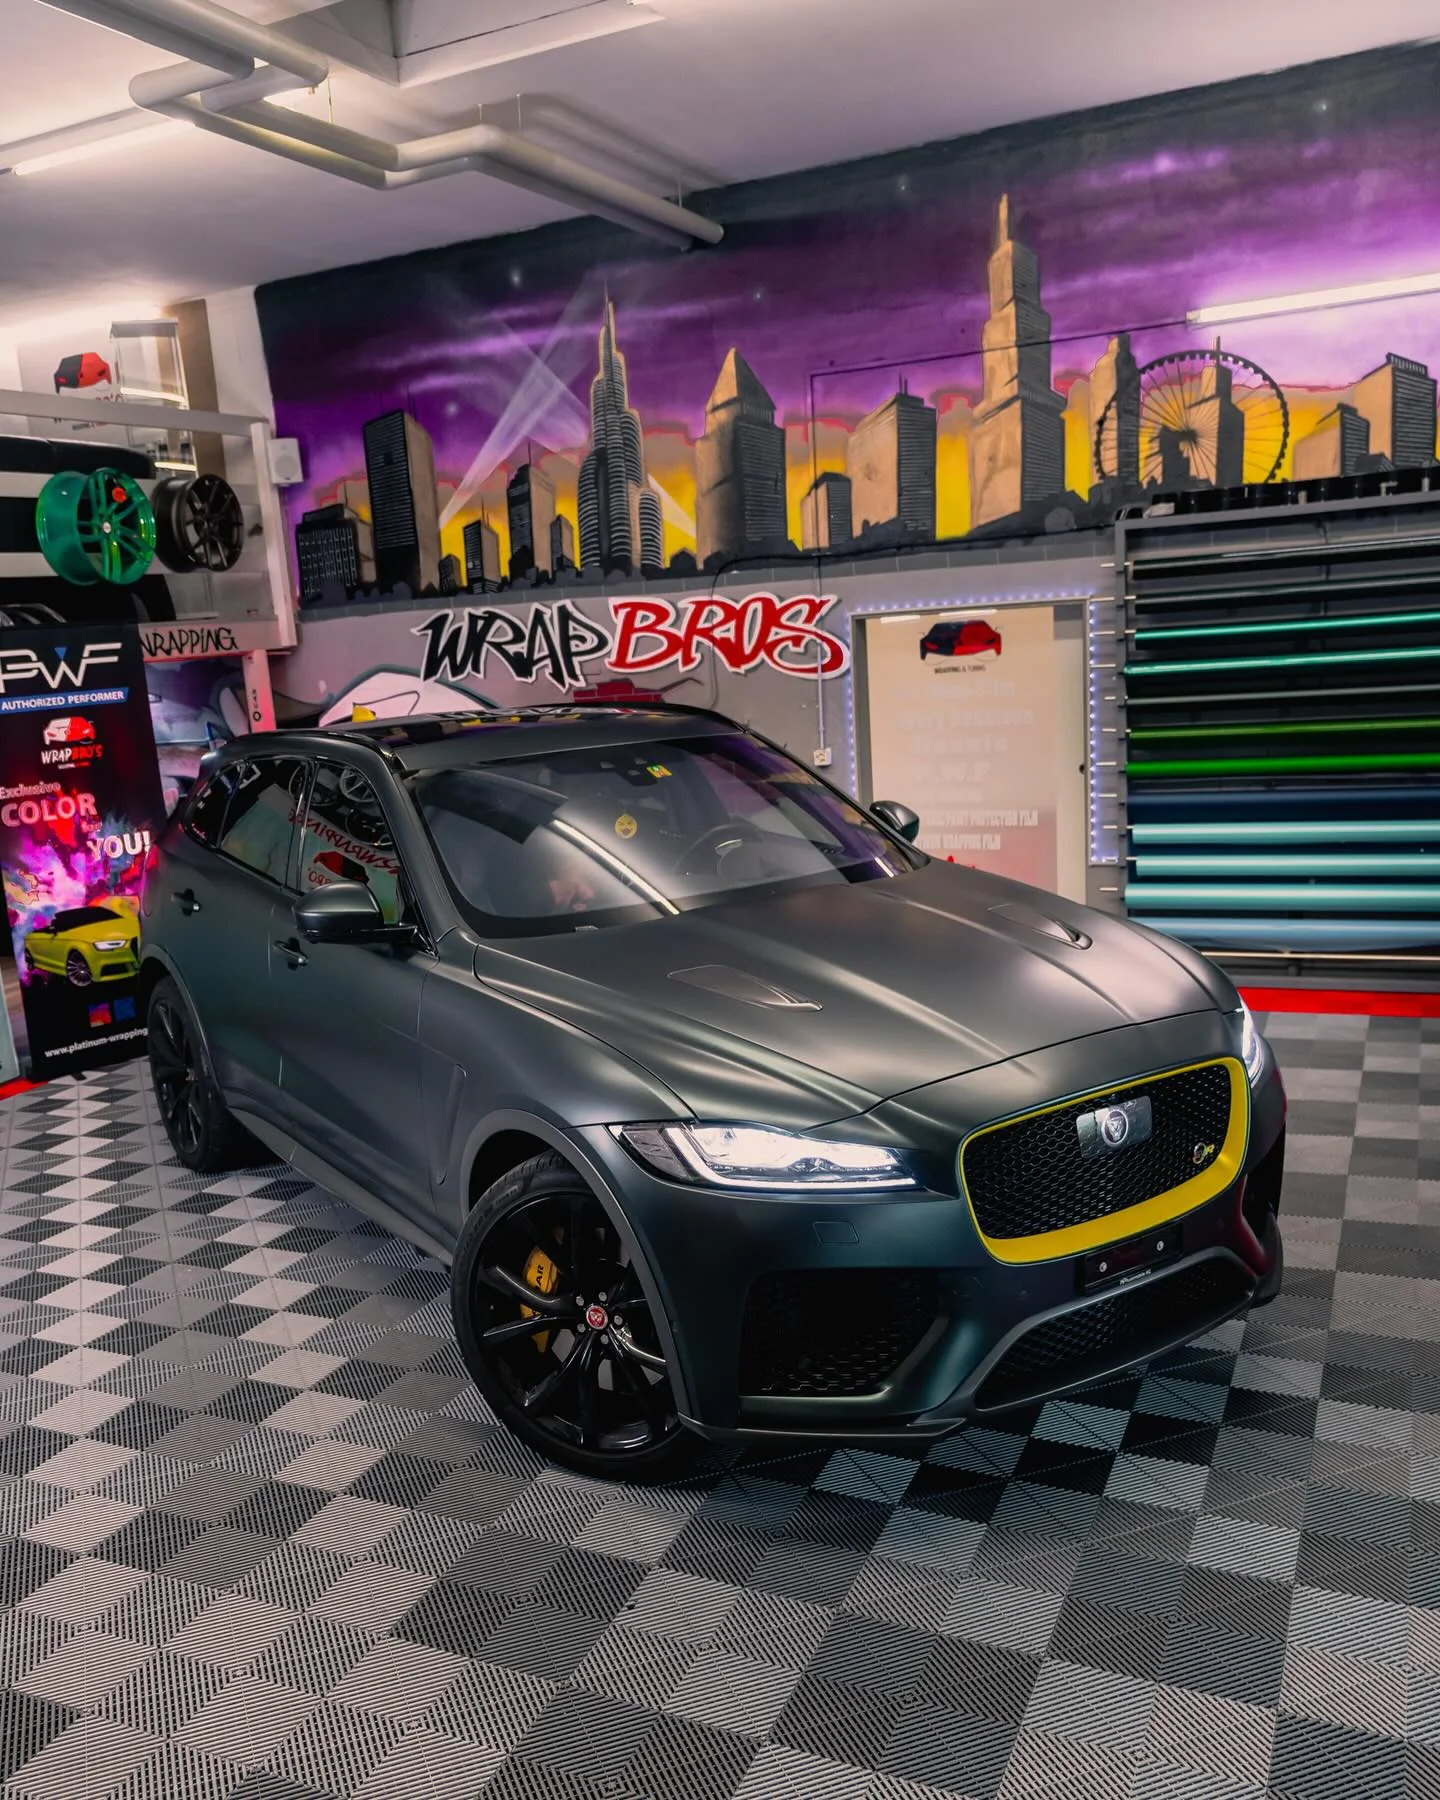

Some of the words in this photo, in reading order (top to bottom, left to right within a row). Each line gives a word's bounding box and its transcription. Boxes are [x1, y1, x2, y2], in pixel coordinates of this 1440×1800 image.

[411, 600, 611, 693] WRAP
[606, 592, 849, 678] BROS
[1, 696, 65, 711] AUTHORIZED
[67, 691, 124, 704] PERFORMER
[1, 793, 98, 827] COLOR
[86, 831, 150, 861] YOU!
